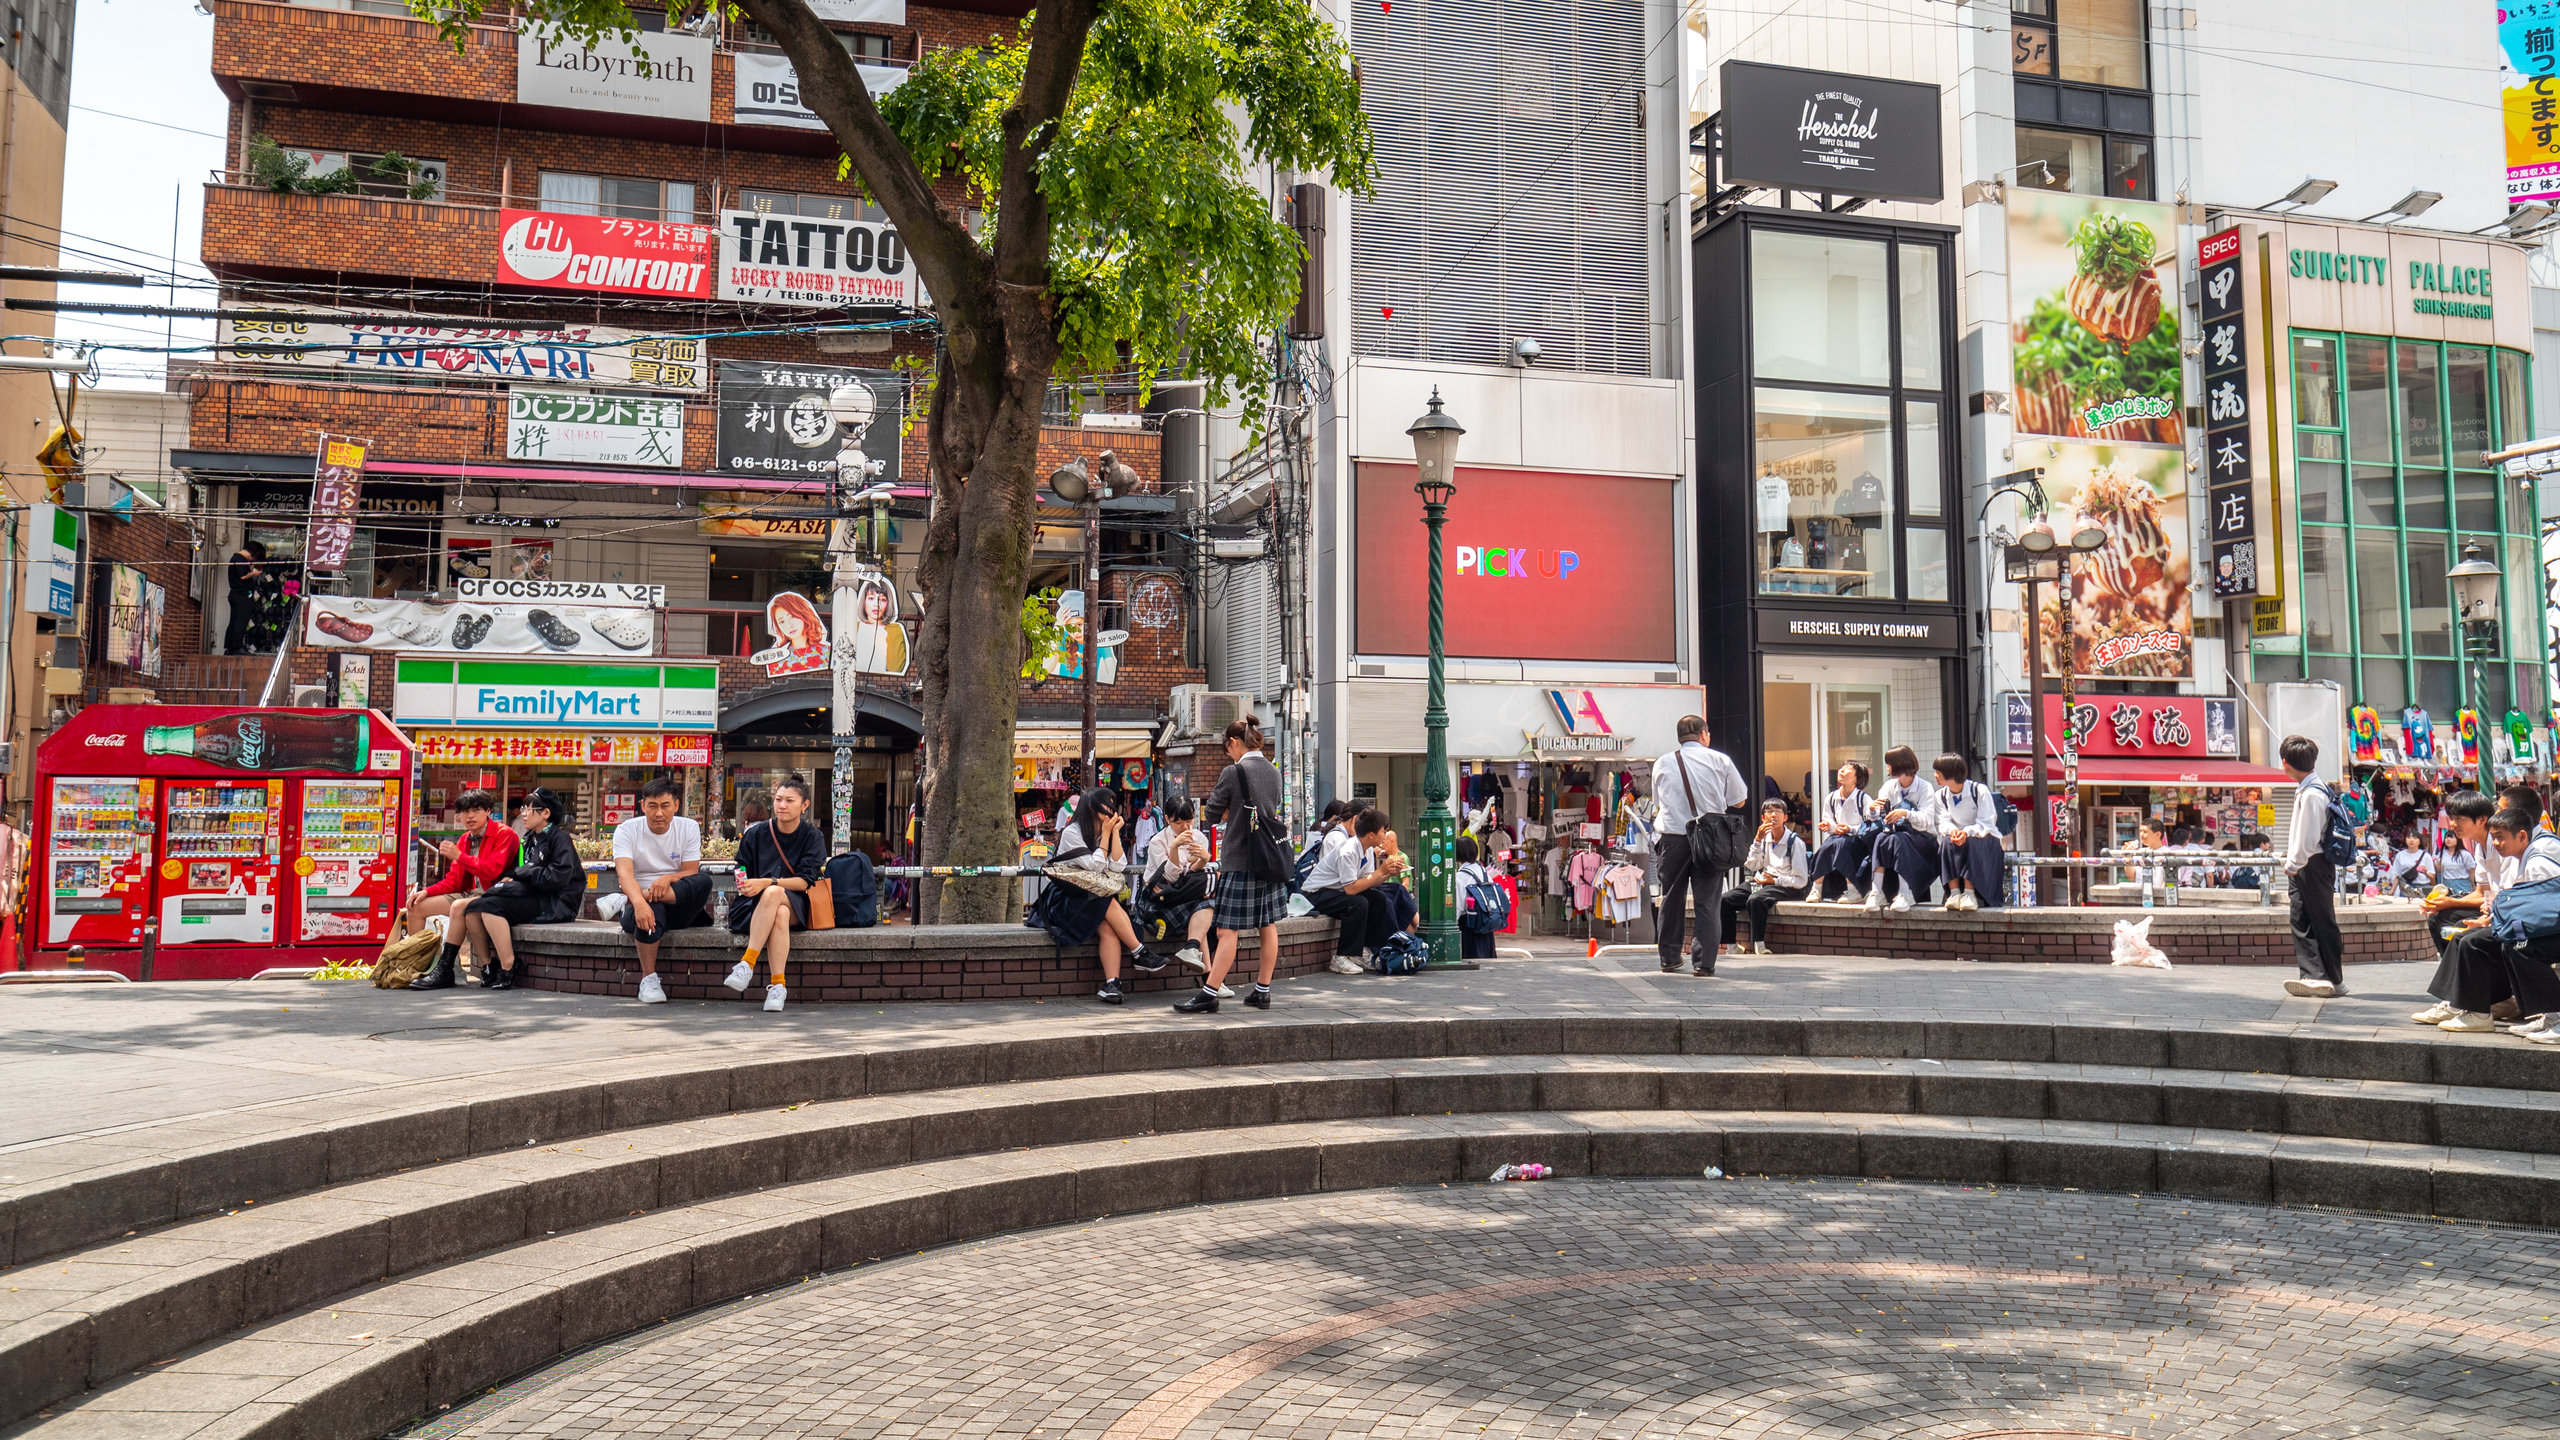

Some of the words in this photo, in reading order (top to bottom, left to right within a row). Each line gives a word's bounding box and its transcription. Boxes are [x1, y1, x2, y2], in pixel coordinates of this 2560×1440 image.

[536, 37, 695, 83] Labyrinth
[570, 86, 590, 95] Like
[592, 89, 609, 97] and
[612, 90, 642, 101] beauty
[644, 95, 660, 103] you
[1815, 92, 1826, 101] THE
[1825, 91, 1842, 100] FINEST
[1842, 93, 1863, 106] QUALITY
[2525, 26, 2560, 154] 揃ってます。
[1797, 99, 1878, 141] Herschel
[1834, 112, 1844, 121] THE
[1819, 137, 1836, 146] SUPPLY
[1844, 140, 1860, 149] BRAND
[1818, 155, 1839, 164] TRADE
[1839, 157, 1860, 166] MARK
[600, 219, 709, 244] ブランド古着
[733, 216, 906, 276] TATTOO
[2202, 235, 2238, 259] SPEC
[692, 253, 707, 264] 4F
[567, 253, 706, 293] COMFORT
[731, 266, 781, 288] LUCKY
[785, 271, 834, 293] ROUND
[838, 275, 905, 299] TATTOO!!
[2290, 248, 2387, 286] SUNCITY
[2410, 260, 2493, 296] PALACE
[2413, 297, 2493, 320] SHINSAIBASHI
[630, 335, 698, 362] 高価
[628, 360, 697, 387] 買取
[761, 369, 861, 389] TATTOO
[511, 393, 681, 428] DCブランド古着
[2209, 266, 2247, 532] 甲賀流本店
[358, 498, 437, 515] CUSTOM
[1455, 545, 1528, 578] PICK
[1537, 548, 1580, 580] UP
[633, 585, 663, 602] 2F
[2255, 600, 2281, 616] WALKIN
[1790, 620, 1841, 635] HERSCHEL
[1844, 622, 1880, 637] SUPPLY
[1882, 624, 1929, 638] COMPANY
[2256, 616, 2279, 632] STORE
[1108, 633, 1128, 642] salon
[2095, 630, 2181, 666] 王道のソースマヨ
[478, 688, 640, 722] FamilyMart
[2073, 701, 2192, 749] 甲賀流
[84, 733, 128, 747] Coca-Cola
[421, 736, 582, 758] ポケチキ新登場!
[308, 918, 343, 929] Welcome
